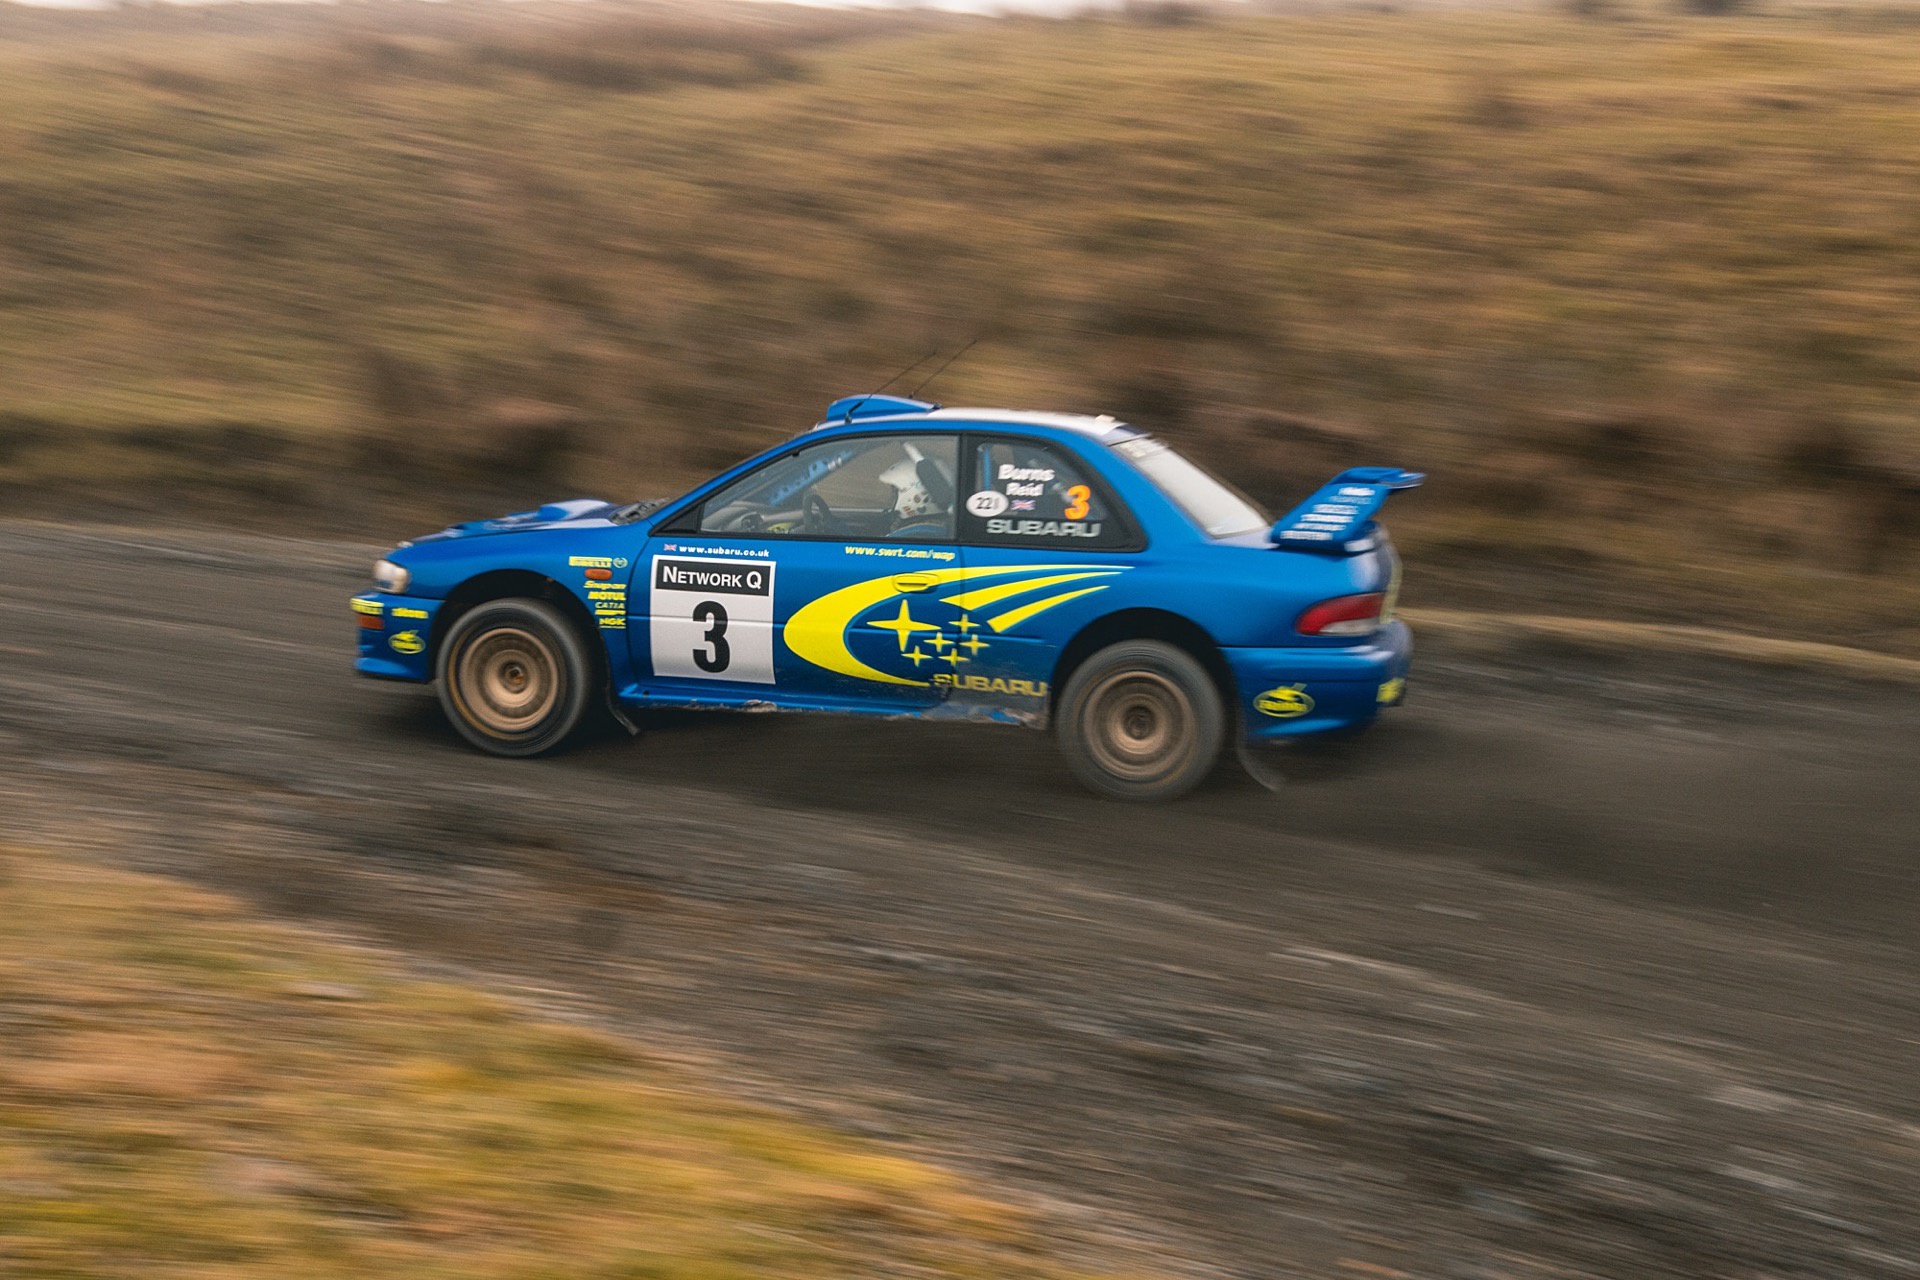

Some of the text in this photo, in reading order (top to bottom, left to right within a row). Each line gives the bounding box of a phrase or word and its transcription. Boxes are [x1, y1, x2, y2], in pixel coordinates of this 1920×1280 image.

[998, 464, 1055, 481] Burns
[1006, 482, 1044, 496] Reid
[1064, 485, 1091, 520] 3
[986, 519, 1101, 537] SUBARU
[679, 545, 769, 557] www.subaru.co.uk
[845, 546, 955, 562] www.swrt.com/wap
[662, 565, 762, 590] NETWORK Q
[588, 591, 627, 601] MOTUL
[599, 617, 627, 626] NGK
[692, 600, 731, 674] 3
[933, 673, 1048, 697] SUBARU
